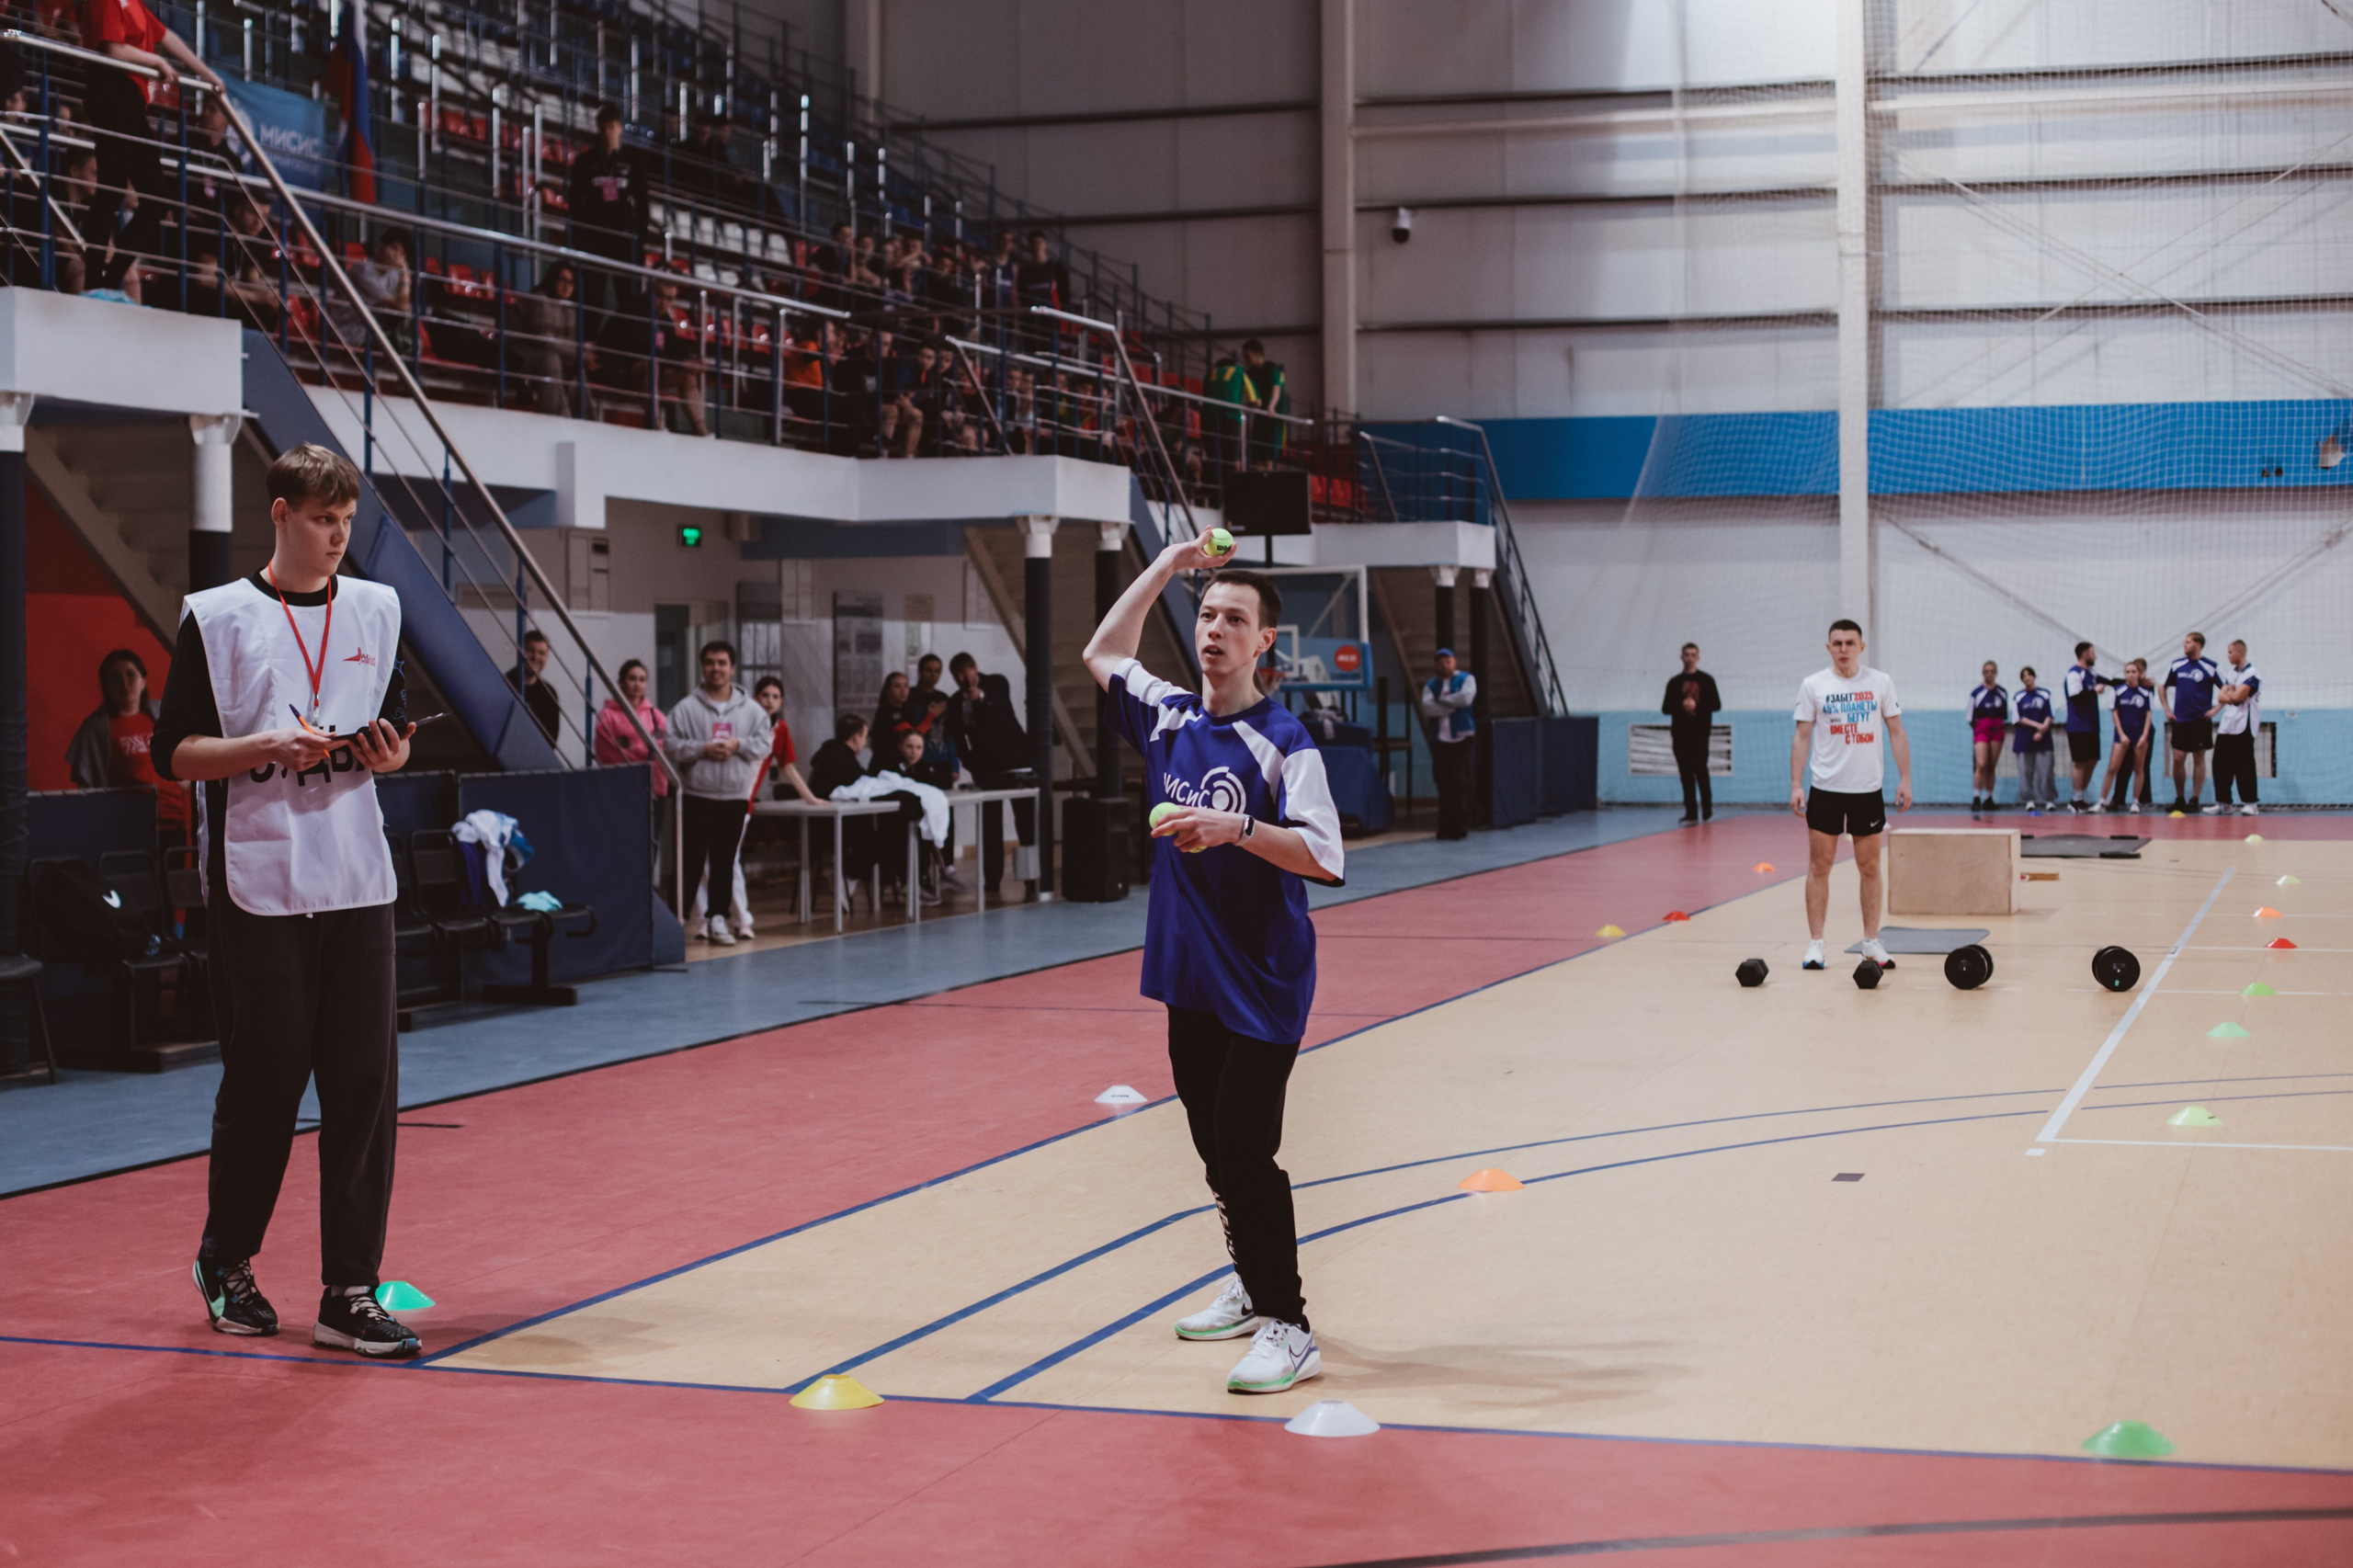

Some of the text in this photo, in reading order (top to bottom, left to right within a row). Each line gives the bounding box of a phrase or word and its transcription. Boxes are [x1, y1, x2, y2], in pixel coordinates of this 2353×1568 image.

[1840, 701, 1877, 712] ПЛАНЕТЫ
[1847, 712, 1869, 722] БЕГУТ
[1830, 723, 1858, 734] ВМЕСТЕ
[1852, 733, 1873, 743] ТОБОЙ
